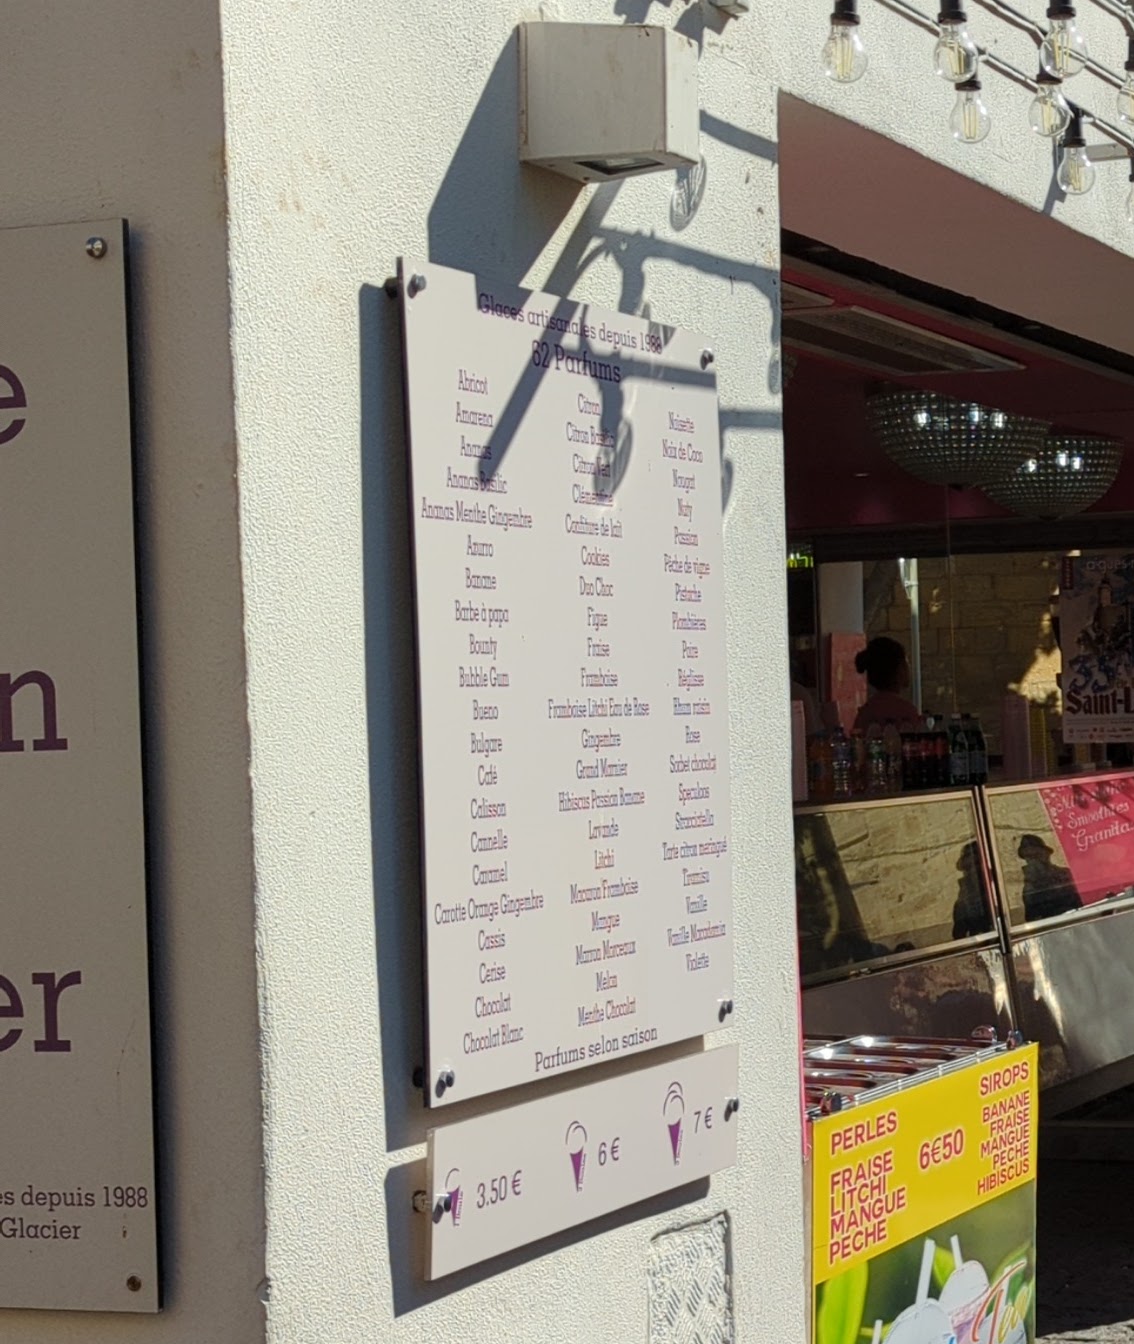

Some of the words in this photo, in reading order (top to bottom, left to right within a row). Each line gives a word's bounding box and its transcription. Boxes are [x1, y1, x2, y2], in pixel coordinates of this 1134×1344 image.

[479, 293, 524, 323] Glaces
[528, 309, 596, 340] artisanales
[598, 322, 637, 351] depuis
[639, 332, 663, 355] 1988
[532, 340, 550, 369] 62
[554, 344, 621, 383] Parfums
[458, 369, 488, 395] Abricot
[455, 401, 494, 427] Amarena
[421, 496, 454, 521] Ananas
[455, 500, 487, 524] Menthe
[488, 504, 533, 531] Gingembre
[465, 567, 497, 590] Banane
[454, 599, 479, 622] Barbe
[481, 602, 487, 622] à
[488, 607, 509, 628] papa
[469, 633, 497, 660] Bounty
[459, 666, 488, 687] Bubble
[489, 666, 510, 687] Gum
[472, 699, 498, 720] Bueno
[477, 764, 498, 786] Café
[470, 798, 507, 819] Calisson
[470, 829, 508, 852] Cannelle
[472, 860, 508, 886] Caramel
[434, 902, 466, 925] Carotte
[468, 897, 499, 921] Orange
[500, 889, 544, 917] Gingembre
[477, 928, 505, 951] Cassis
[479, 962, 506, 984] Cerise
[475, 992, 512, 1018] Chocolat
[463, 1027, 500, 1054] Chocolat
[501, 1023, 524, 1046] Blanc
[535, 1047, 585, 1072] Parfums
[588, 1035, 619, 1058] selon
[622, 1026, 657, 1048] saison
[980, 1061, 1029, 1096] SIROPS
[694, 1111, 702, 1134] 7
[704, 1107, 713, 1130] €
[983, 1090, 1030, 1122] BANANE
[831, 1111, 898, 1155] PERLES
[990, 1107, 1030, 1136] FRAISE
[598, 1142, 607, 1166] 6
[611, 1137, 620, 1161] €
[920, 1129, 964, 1170] 6€50
[981, 1123, 1030, 1158] MANGUE
[993, 1140, 1029, 1170] PECHE
[831, 1150, 893, 1194] FRAISE
[977, 1158, 1029, 1196] HIBISCUS
[21, 1184, 96, 1212] depuis
[103, 1185, 149, 1208] 1988
[477, 1175, 507, 1209] 3.50
[511, 1170, 522, 1196] €
[831, 1175, 886, 1216] LITCHI
[831, 1187, 905, 1239] MANGUE
[0, 1216, 82, 1240] Glacier
[830, 1219, 887, 1264] PECHE
